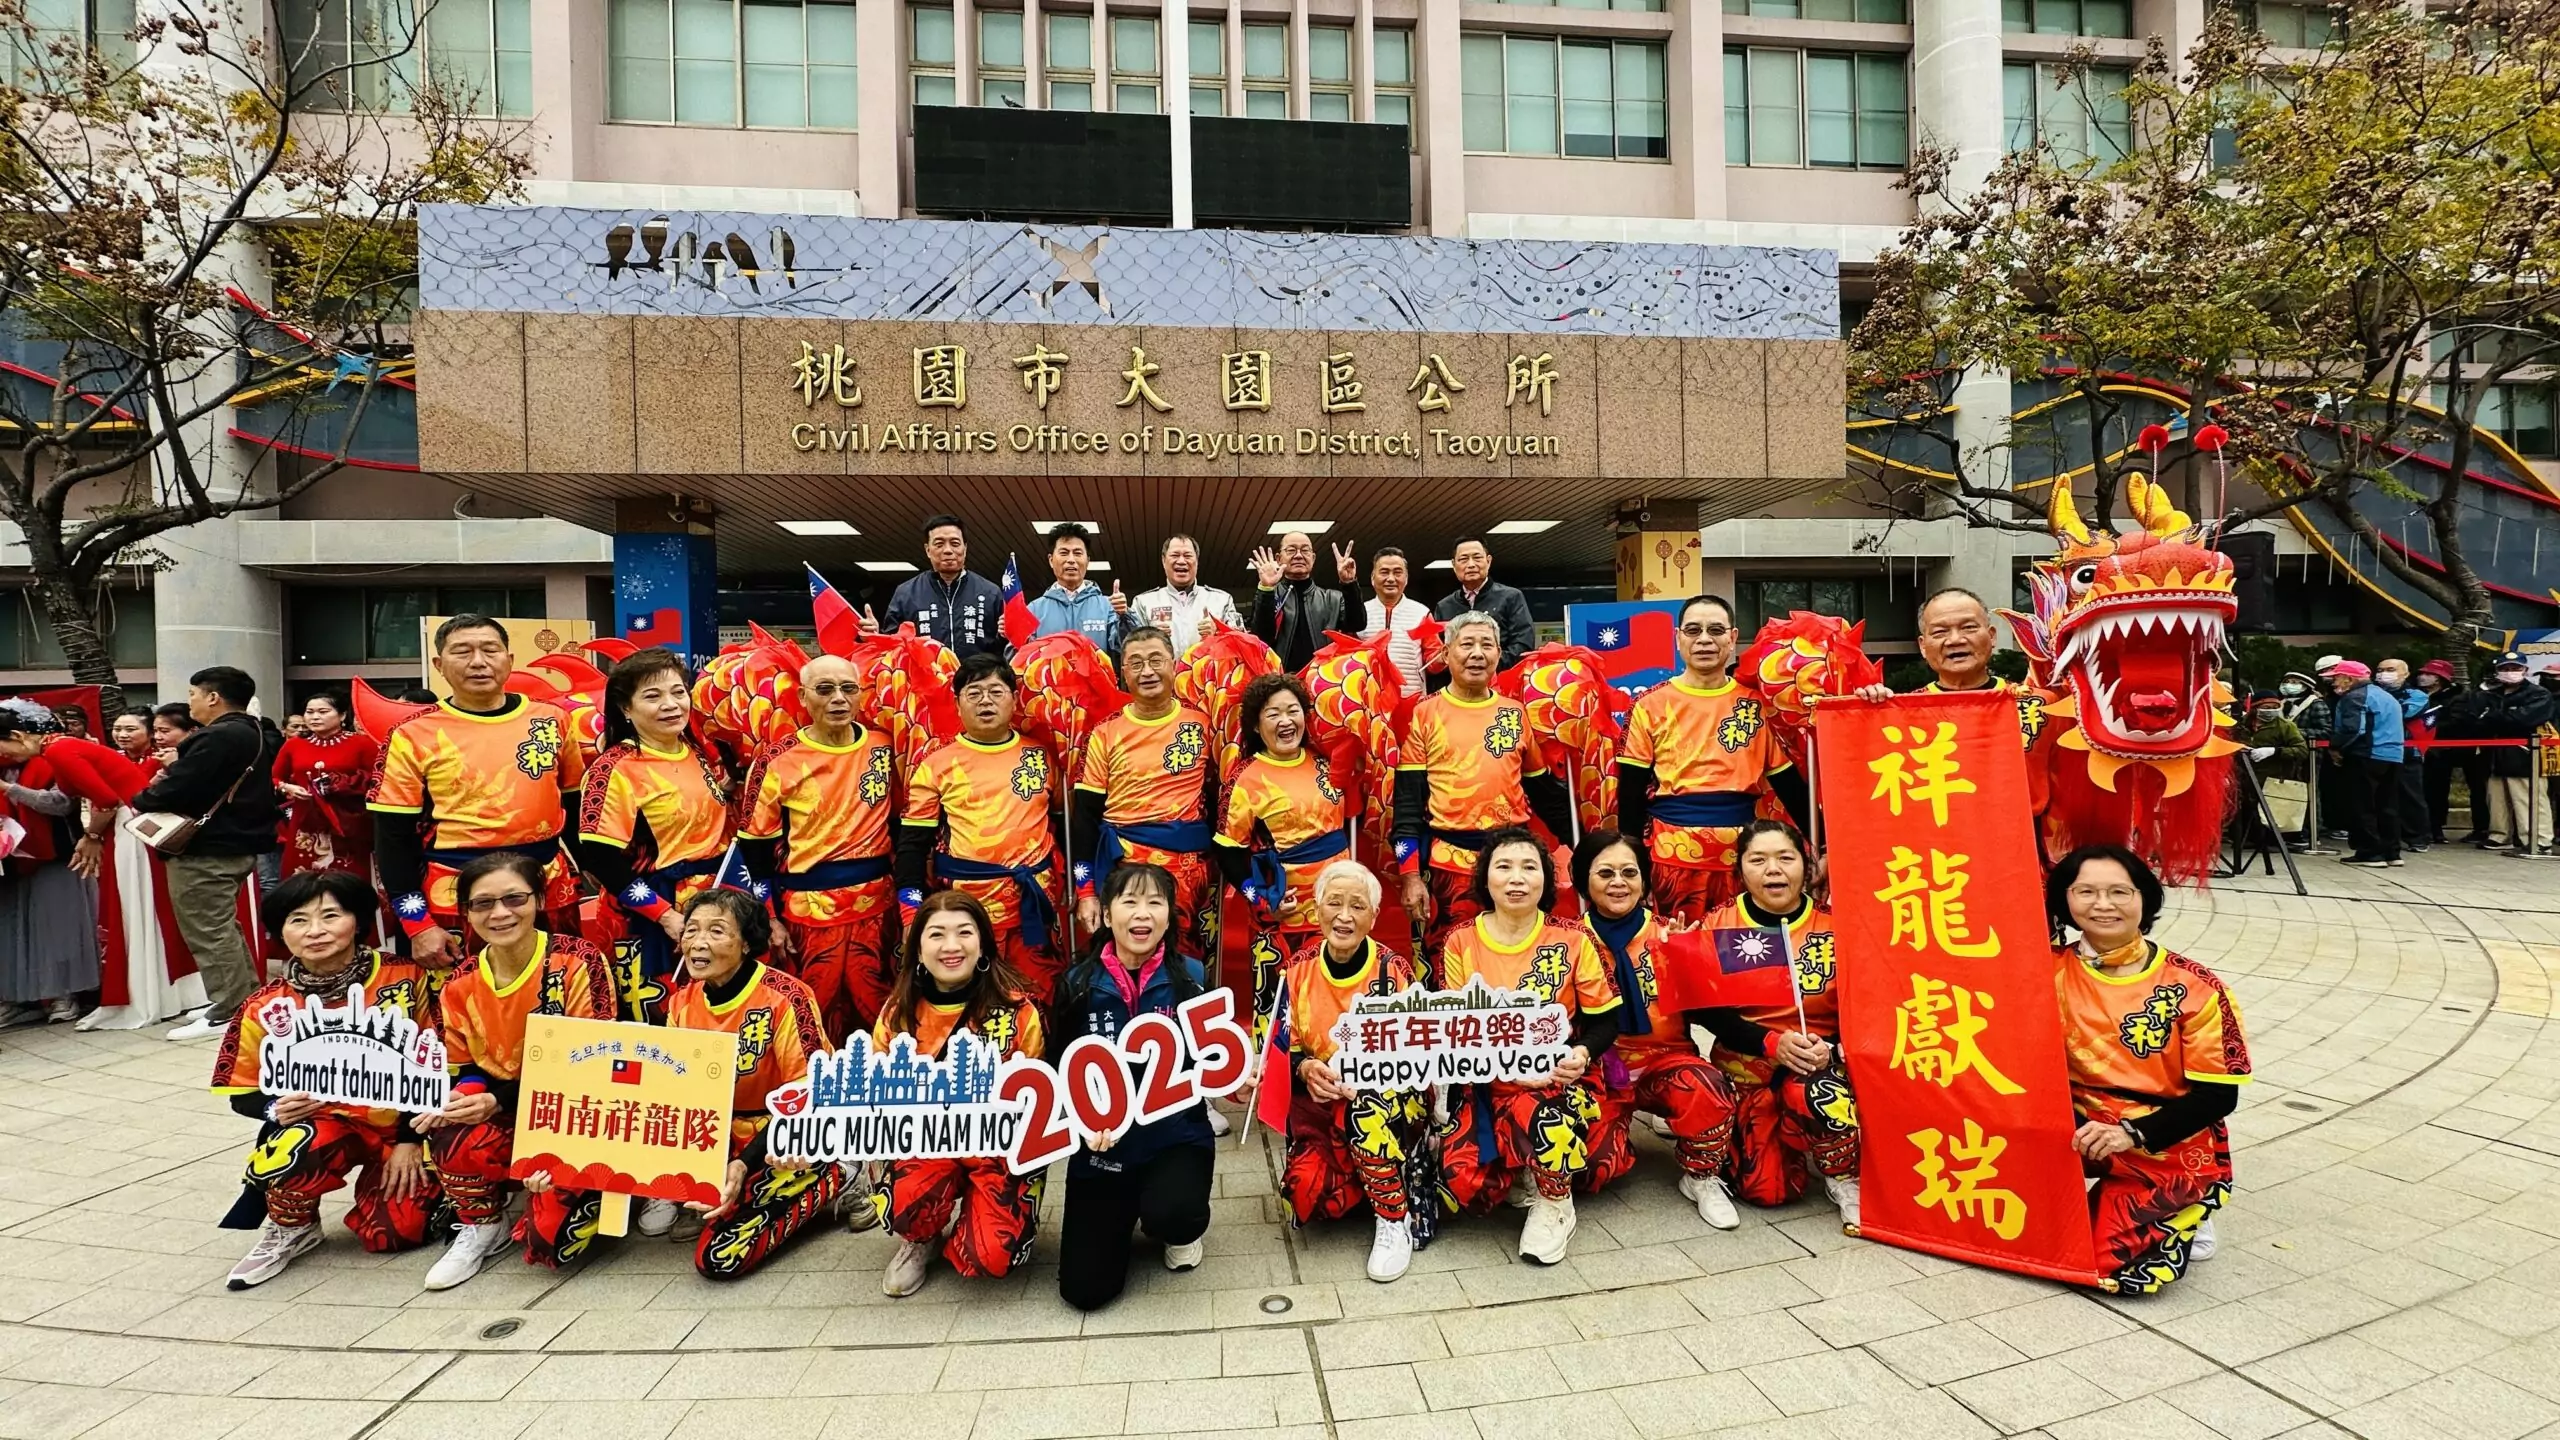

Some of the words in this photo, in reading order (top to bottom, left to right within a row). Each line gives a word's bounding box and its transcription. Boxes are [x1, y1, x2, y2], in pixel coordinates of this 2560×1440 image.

[791, 340, 1560, 417] 桃園市大園區公所
[792, 422, 870, 452] Civil
[879, 423, 998, 453] Affairs
[1008, 424, 1109, 454] Office
[1119, 425, 1154, 454] of
[1163, 426, 1285, 460] Dayuan
[1296, 429, 1421, 460] District,
[1430, 429, 1560, 462] Taoyuan
[522, 719, 561, 777] 祥和
[1166, 723, 1204, 774] 祥和
[1487, 709, 1522, 755] 祥和
[1721, 699, 1762, 751] 祥和
[861, 748, 892, 806] 祥和
[1014, 749, 1048, 798] 祥和
[1867, 722, 2028, 1240] 祥龍獻瑞
[322, 1036, 384, 1053] INDONESIA
[1360, 1012, 1526, 1054] 新年快樂
[2123, 986, 2184, 1055] 祥和
[264, 1042, 337, 1097] Selamat
[342, 1053, 394, 1102] tahun
[400, 1057, 442, 1109] baru
[1000, 997, 1247, 1166] 2025
[1340, 1056, 1430, 1086] Happy
[1438, 1053, 1492, 1078] New
[1498, 1049, 1566, 1075] Year
[528, 1089, 721, 1152] 閩南祥龍隊
[773, 1105, 836, 1157] CHÚC
[844, 1102, 914, 1155] MỪNG
